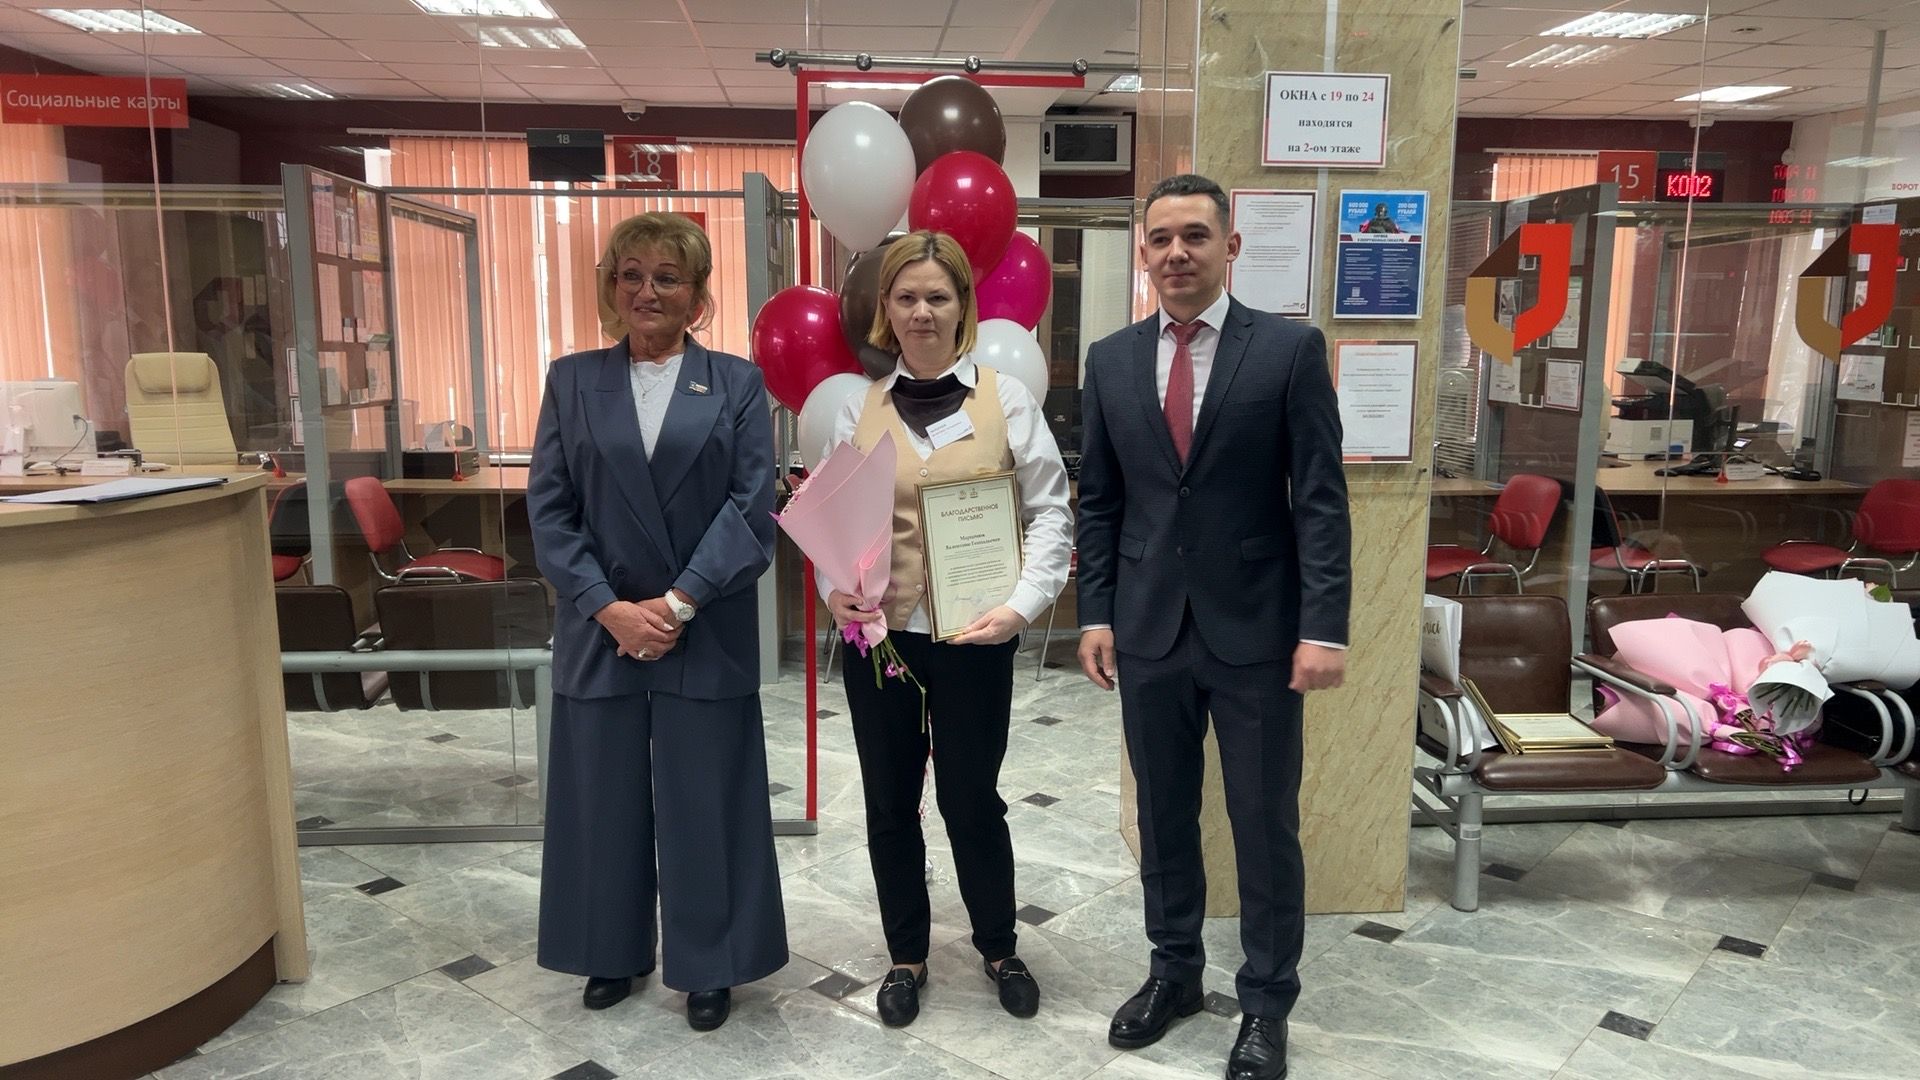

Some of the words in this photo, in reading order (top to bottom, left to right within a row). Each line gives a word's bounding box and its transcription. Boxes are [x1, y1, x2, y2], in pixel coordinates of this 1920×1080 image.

[6, 89, 121, 109] Социальные
[127, 95, 181, 110] карты
[1279, 89, 1317, 101] ОКНА
[1320, 93, 1327, 101] с
[1330, 91, 1343, 101] 19
[1345, 93, 1359, 102] по
[1362, 91, 1375, 102] 24
[1298, 118, 1353, 128] находятся
[556, 133, 570, 145] 18
[1287, 144, 1301, 152] на
[1303, 142, 1327, 153] 2-ом
[1331, 145, 1361, 154] этаже
[628, 150, 662, 176] 18
[1610, 164, 1640, 189] 15
